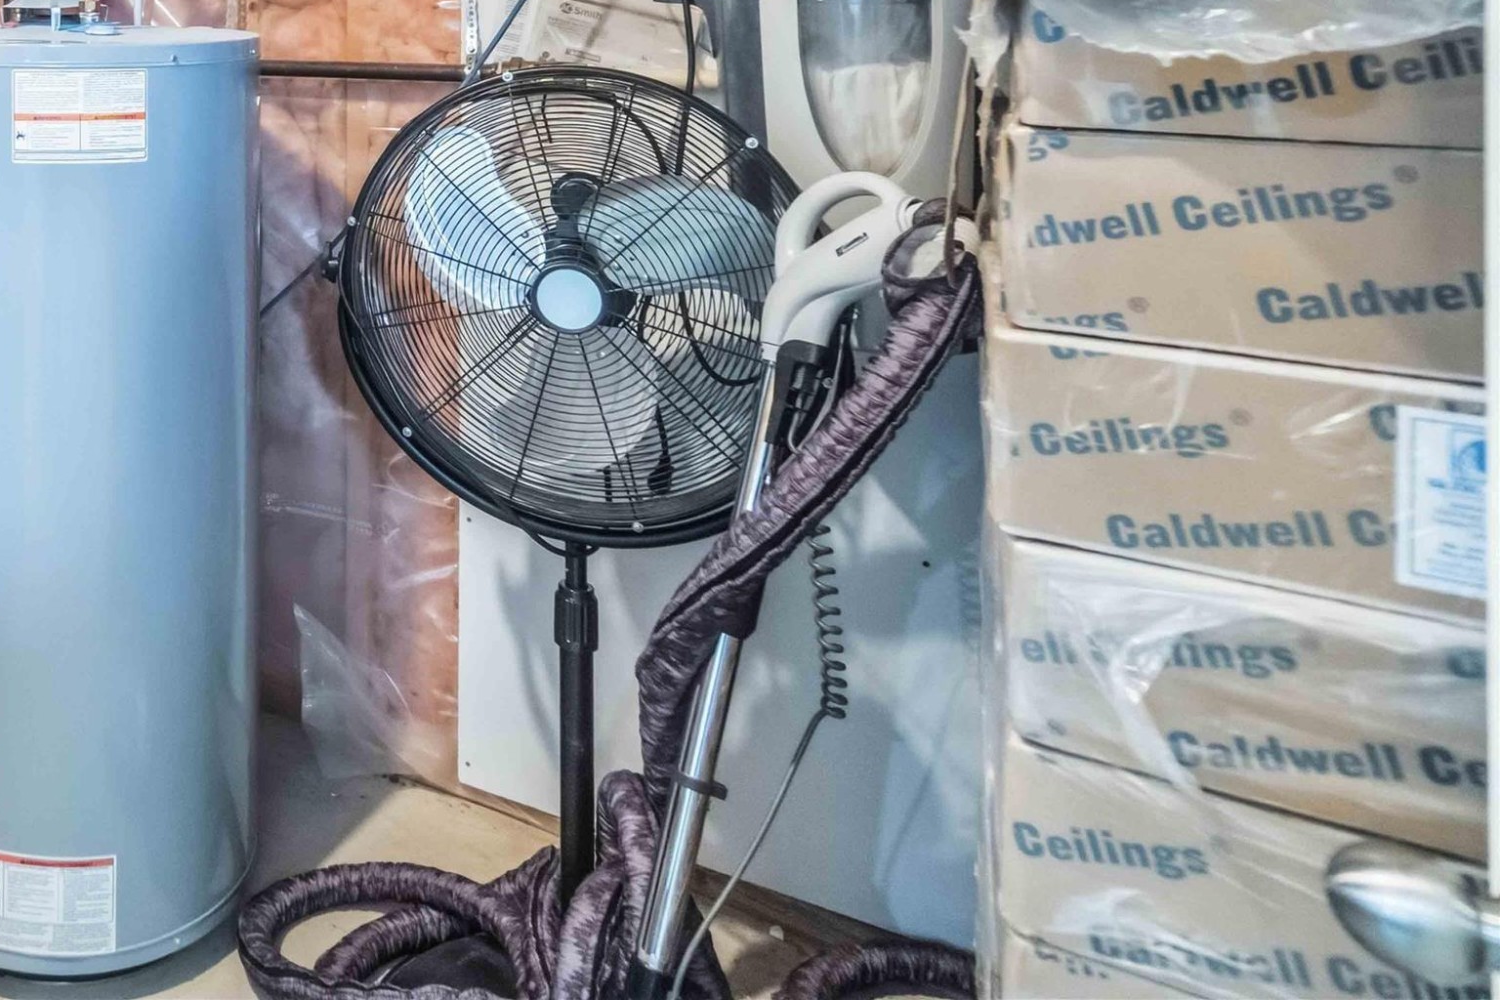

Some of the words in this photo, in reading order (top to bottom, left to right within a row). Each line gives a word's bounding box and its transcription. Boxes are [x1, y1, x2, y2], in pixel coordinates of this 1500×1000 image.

[1108, 59, 1334, 126] Caldwell
[1027, 202, 1161, 248] dwell
[1173, 181, 1394, 232] Ceilings
[1030, 416, 1230, 459] Ceilings
[1106, 511, 1333, 549] Caldwell
[1166, 730, 1406, 783] Caldwell
[1013, 821, 1211, 880] Ceilings
